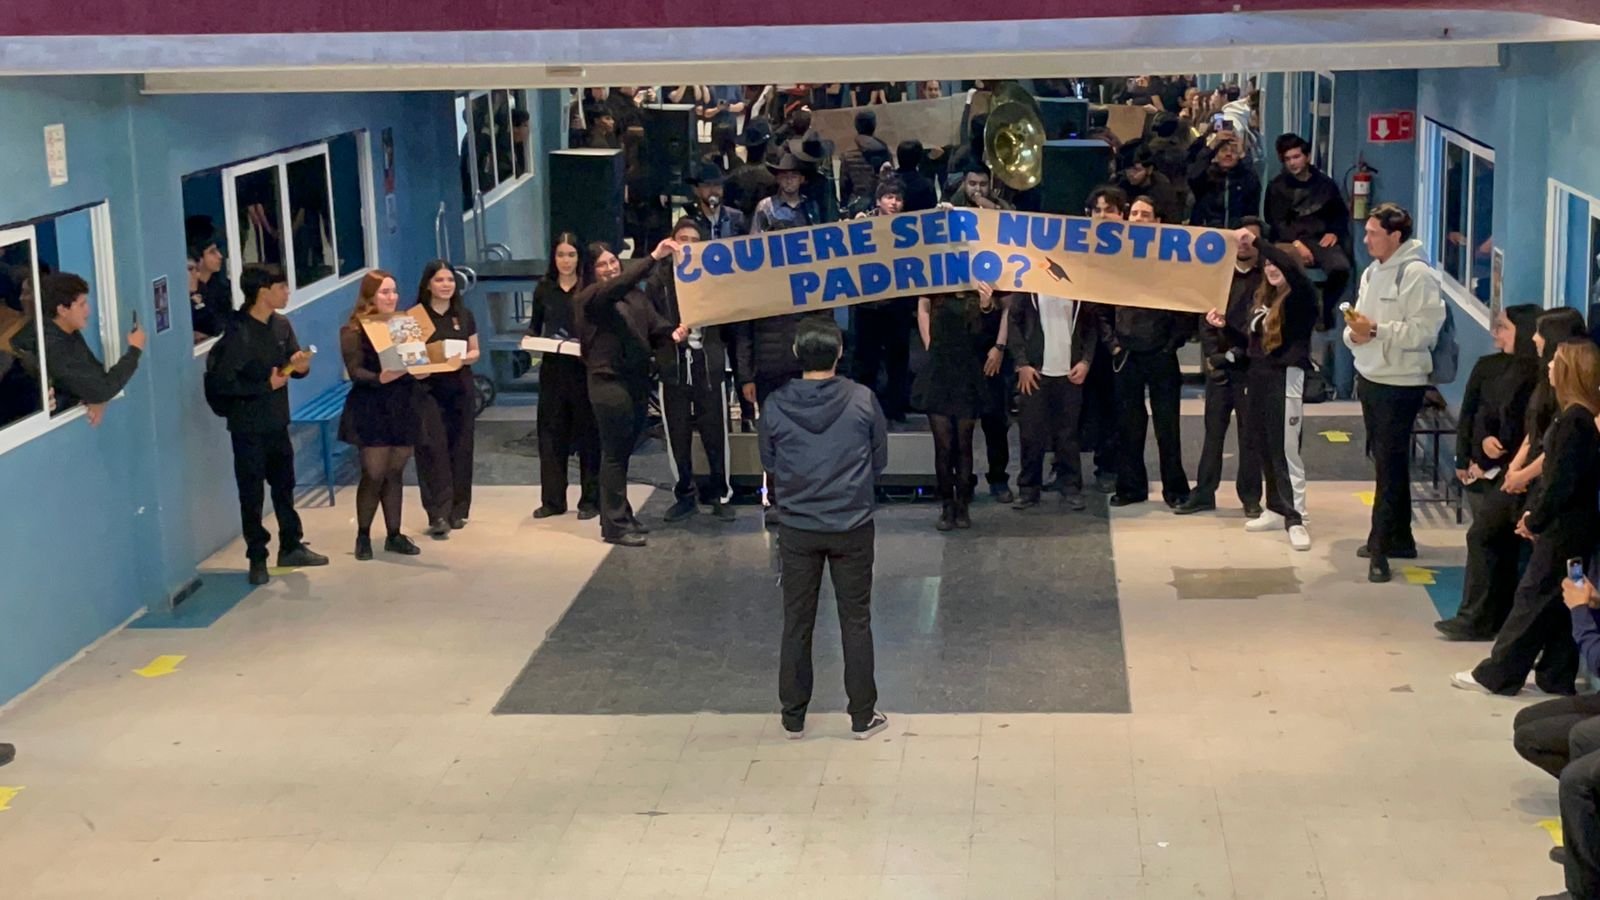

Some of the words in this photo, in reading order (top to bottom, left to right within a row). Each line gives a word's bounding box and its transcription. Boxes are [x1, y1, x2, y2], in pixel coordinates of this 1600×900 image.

[676, 221, 877, 283] ¿QUIERE
[891, 209, 980, 249] SER
[997, 212, 1227, 264] NUESTRO
[789, 250, 1031, 306] PADRINO?
